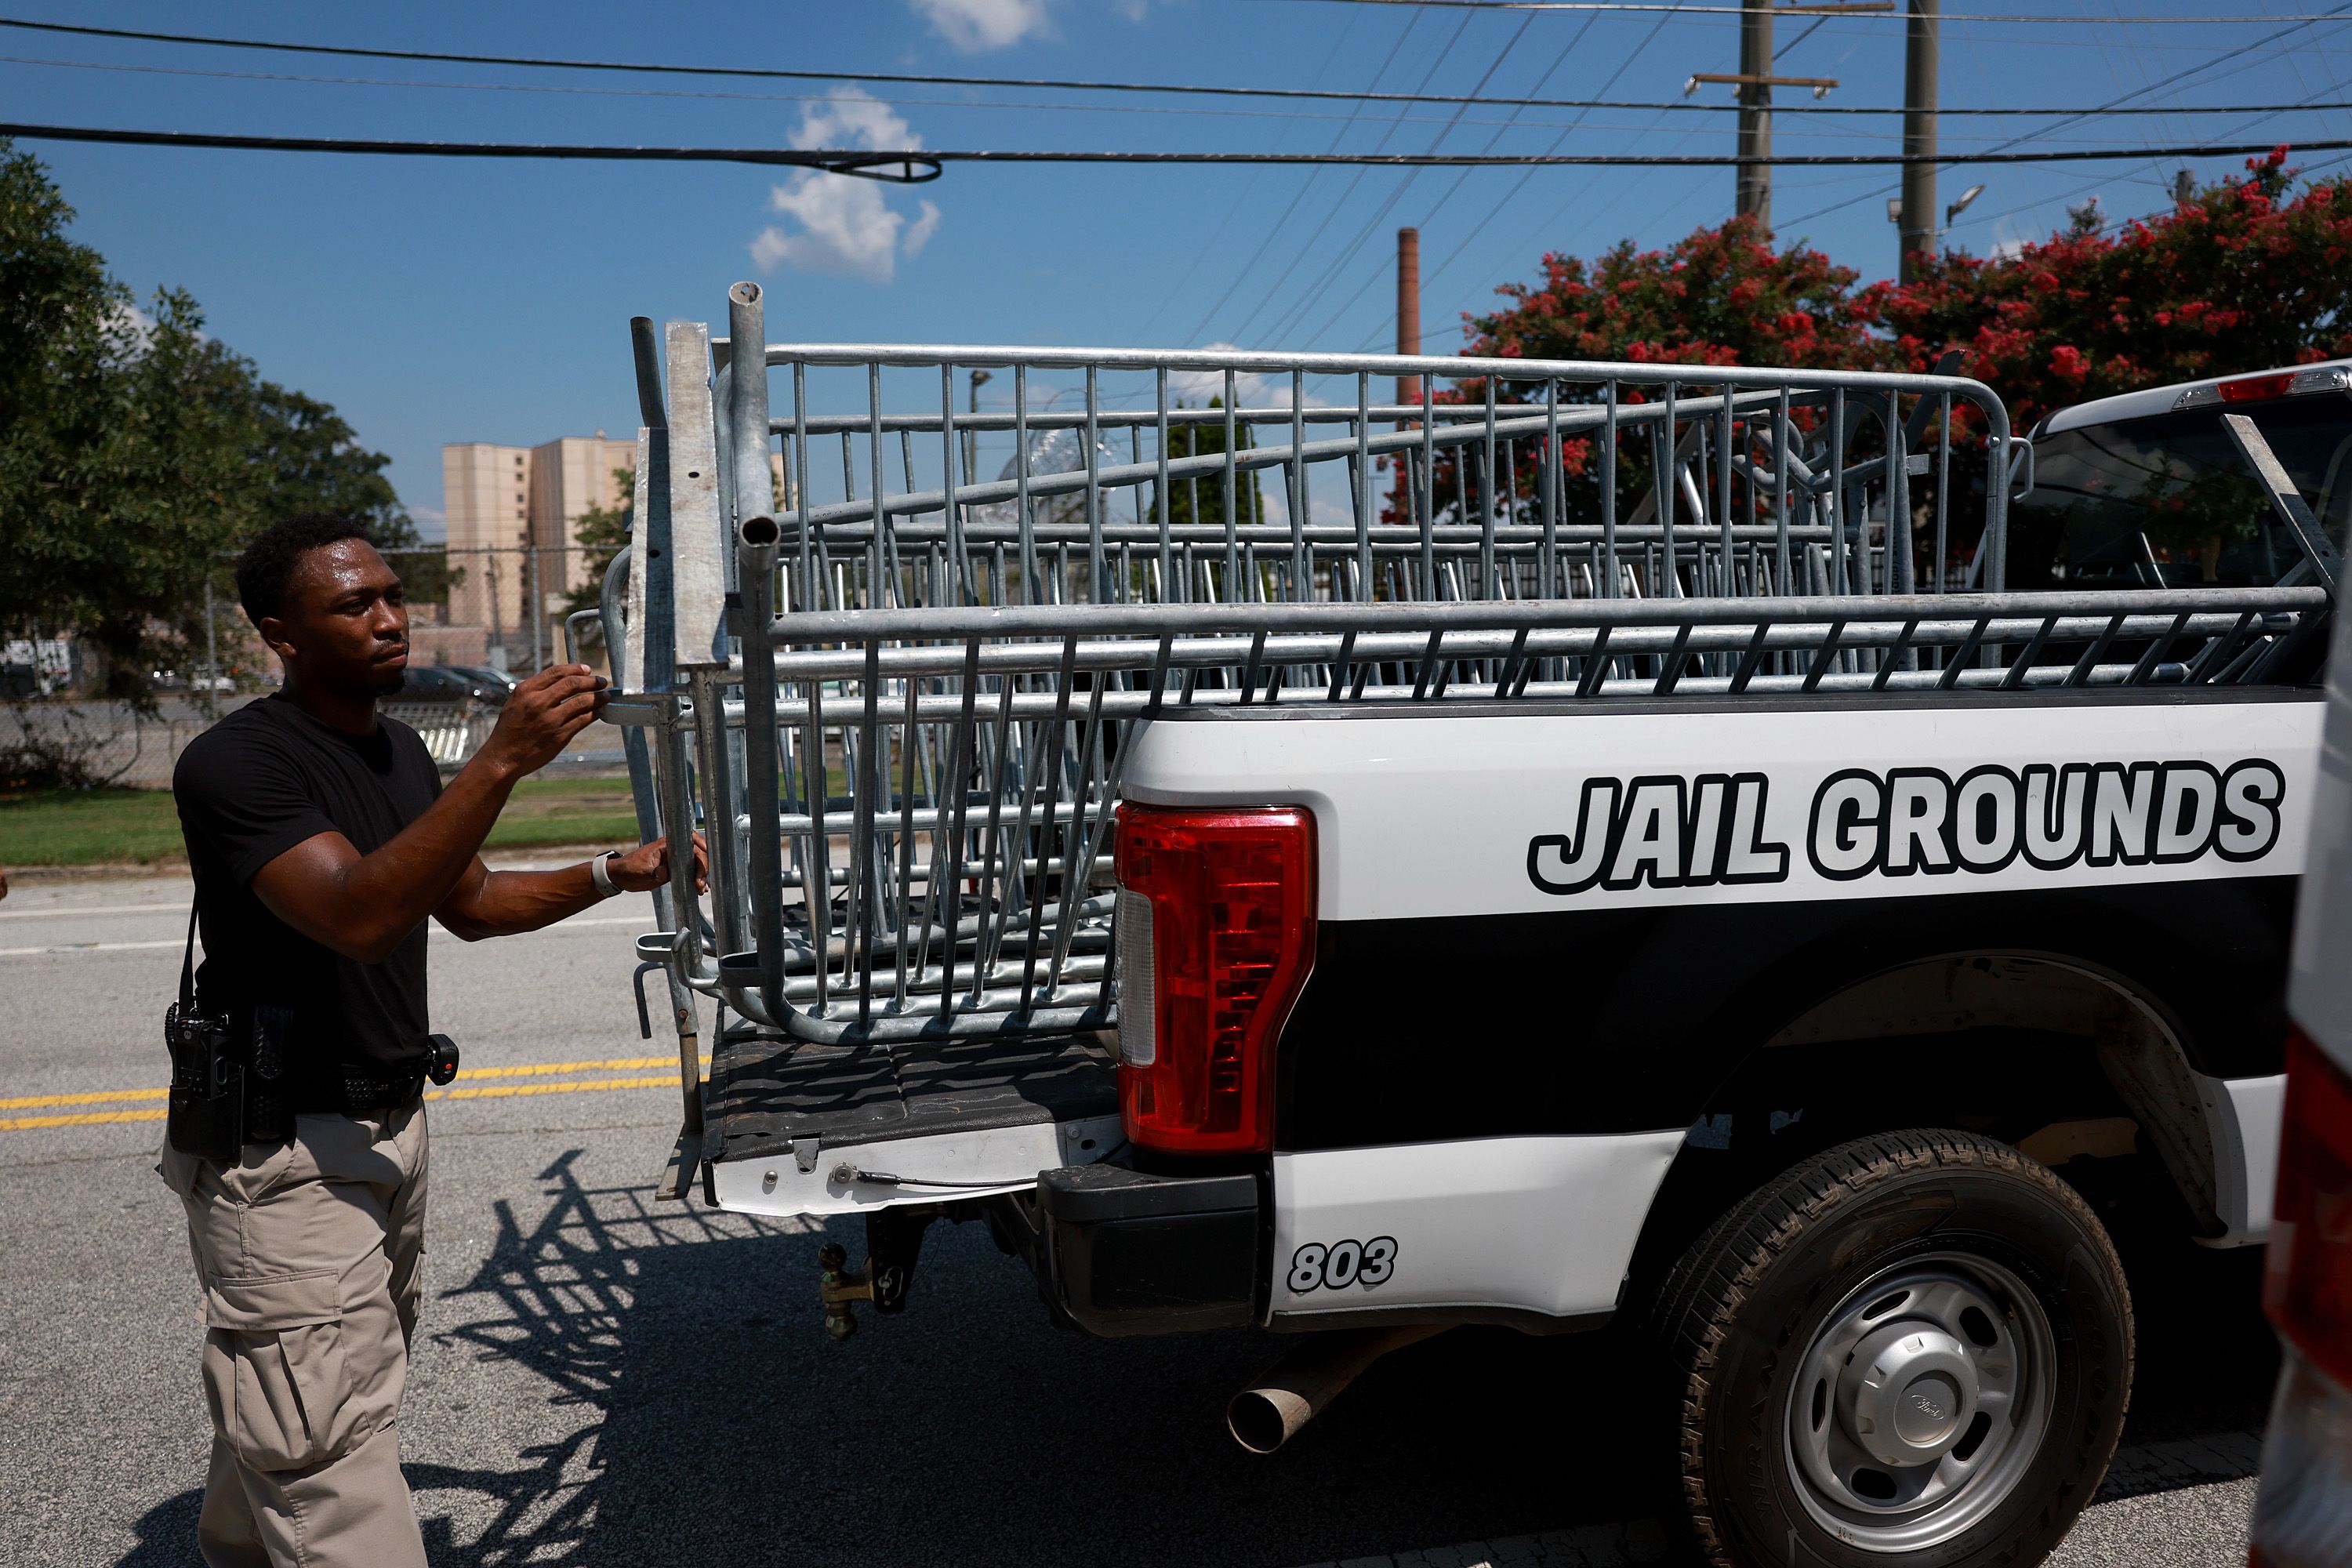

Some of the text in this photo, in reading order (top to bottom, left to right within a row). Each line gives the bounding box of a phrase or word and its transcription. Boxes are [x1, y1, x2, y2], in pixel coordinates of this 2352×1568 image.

[1526, 758, 2285, 895] JAIL GROUNDS
[1287, 1236, 1399, 1293] 803
